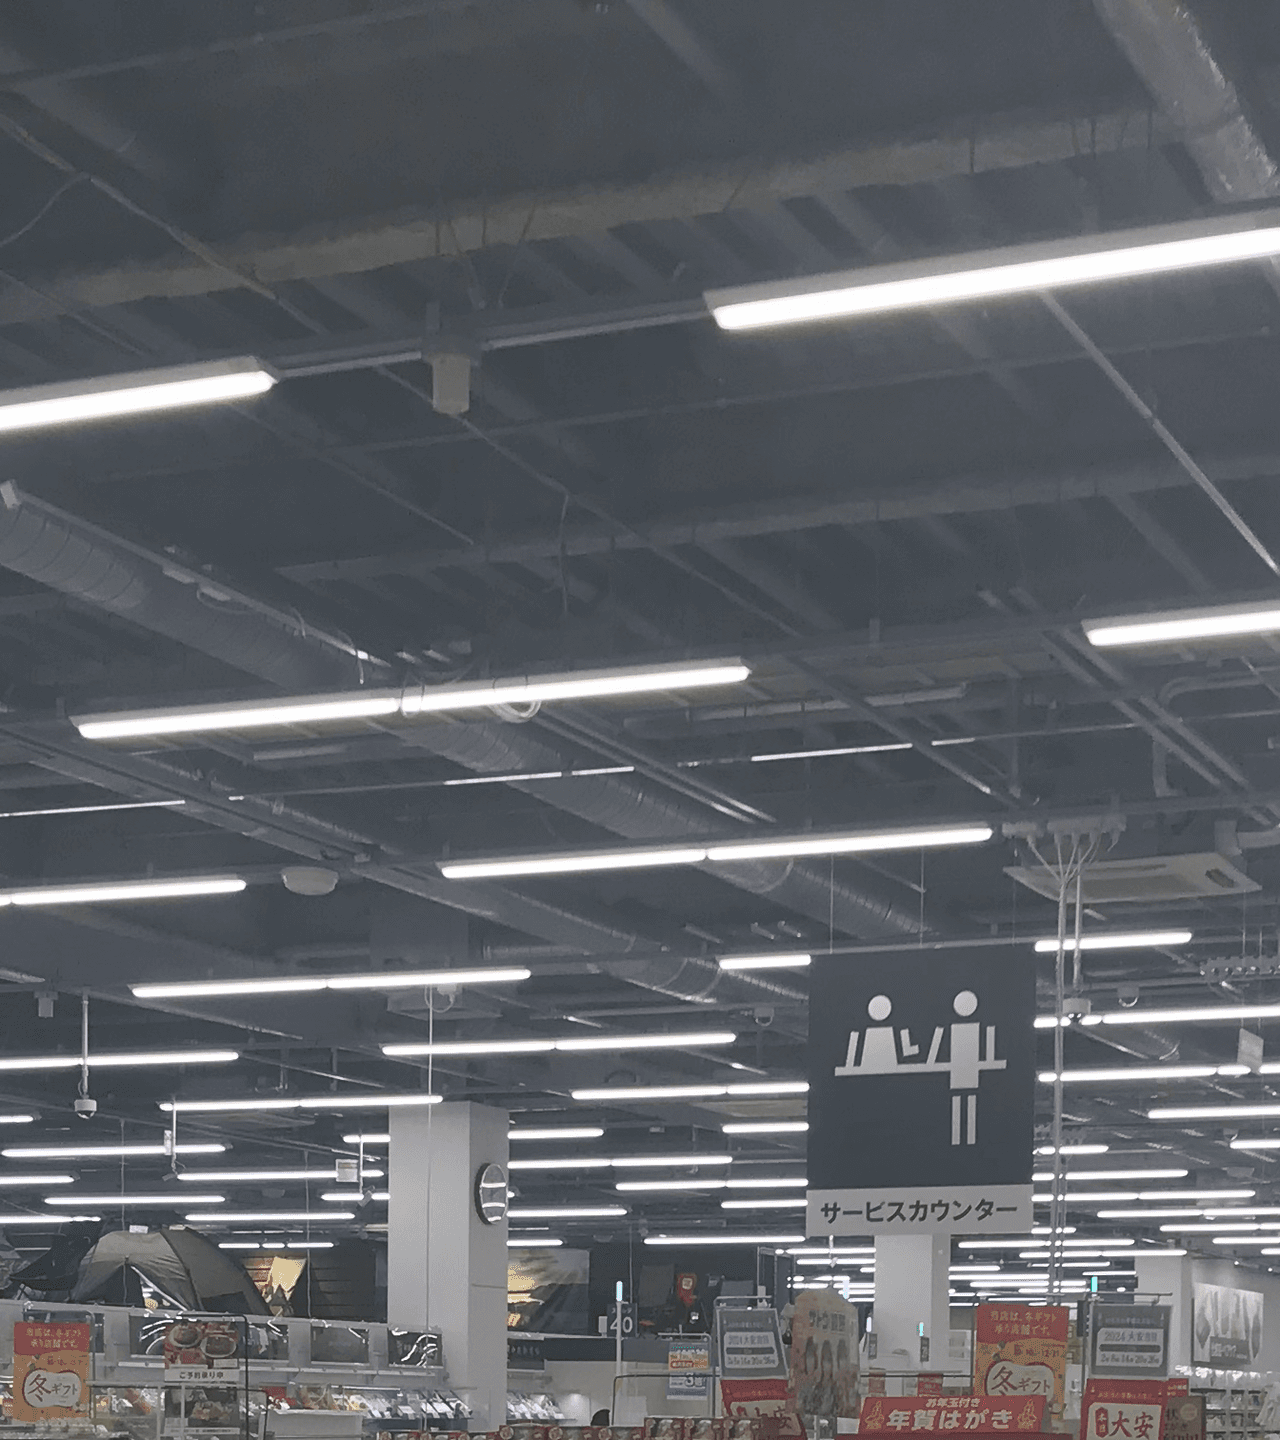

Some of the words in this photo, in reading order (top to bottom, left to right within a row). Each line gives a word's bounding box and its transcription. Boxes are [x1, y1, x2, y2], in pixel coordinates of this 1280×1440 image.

[820, 1198, 1018, 1225] サービスカウンター
[27, 1373, 78, 1403] 冬ギフト
[990, 1365, 1051, 1396] 冬ギフト
[924, 1397, 982, 1408] お年玉付き
[886, 1407, 1013, 1431] 年賀はがき
[1108, 1410, 1154, 1440] 大安
